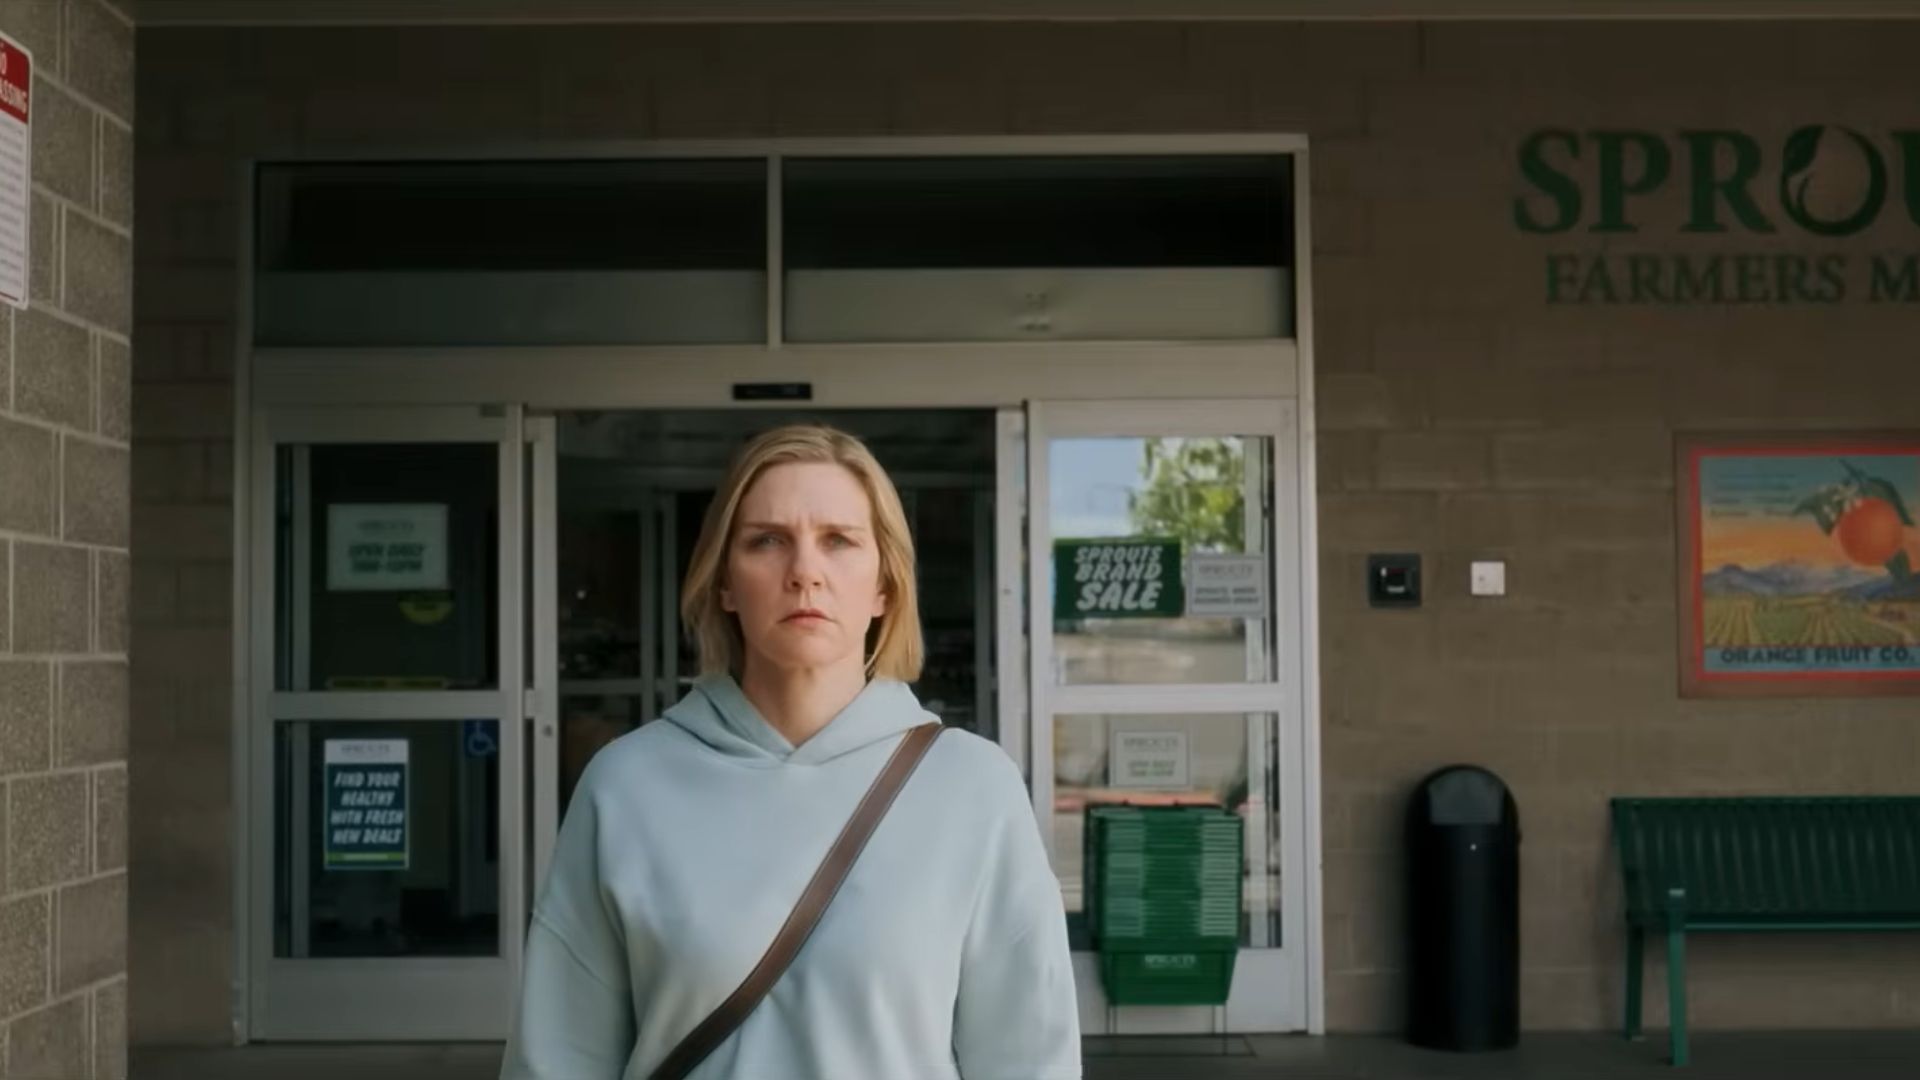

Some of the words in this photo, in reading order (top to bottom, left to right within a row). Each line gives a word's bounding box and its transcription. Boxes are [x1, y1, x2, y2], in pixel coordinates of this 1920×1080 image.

[1545, 252, 1847, 305] FARMERS
[1074, 546, 1163, 565] SPROUTS
[1074, 562, 1163, 582] BRAND
[1075, 581, 1163, 610] SALE
[1720, 647, 1805, 663] ORANGE
[1814, 646, 1872, 663] FRUIT
[1879, 646, 1915, 663] CO.
[334, 771, 365, 787] FIND
[367, 771, 401, 787] YOUR
[340, 790, 396, 806] HEALTHY
[330, 809, 363, 824] WITH
[364, 809, 404, 824] FRESH
[332, 828, 362, 844] NEW
[362, 828, 403, 844] DEALS
